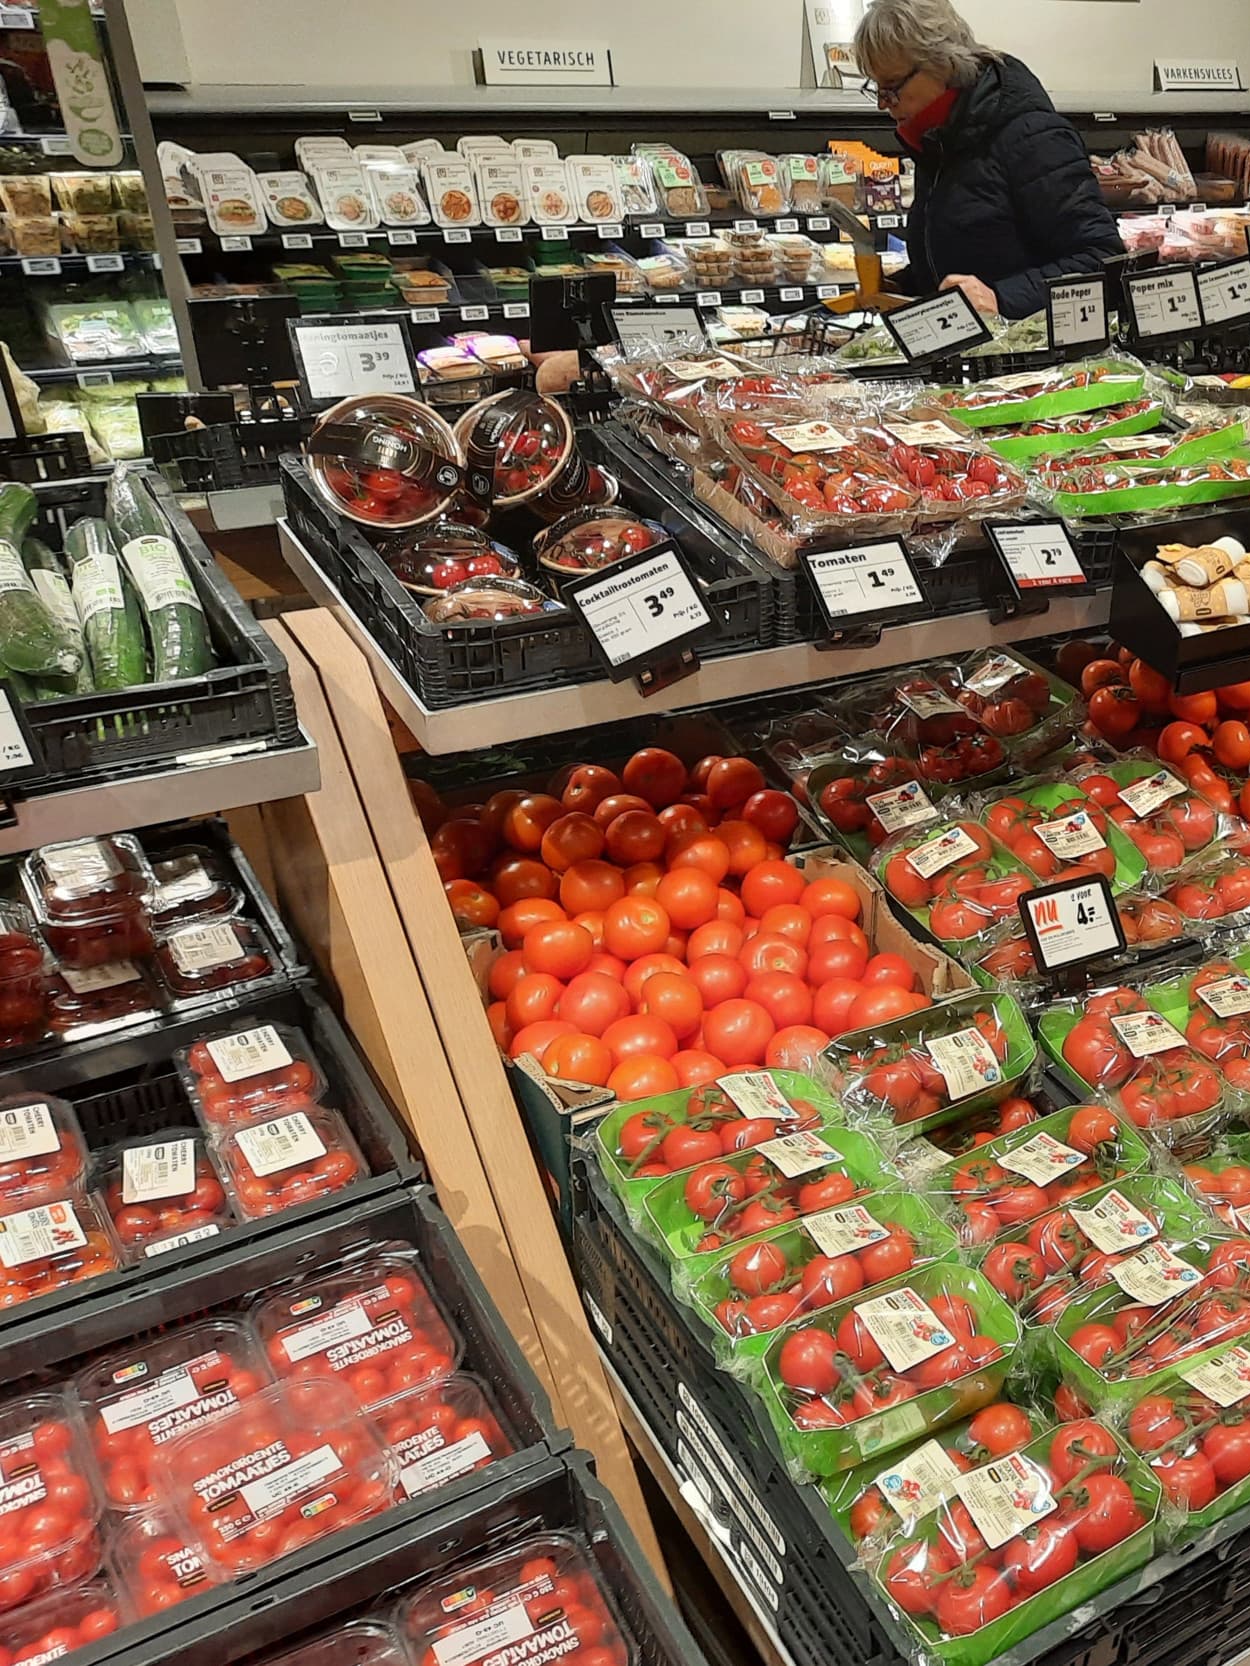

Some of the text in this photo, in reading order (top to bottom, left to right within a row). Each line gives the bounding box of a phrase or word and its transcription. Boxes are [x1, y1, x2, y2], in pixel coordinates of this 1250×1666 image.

[497, 50, 595, 66] VEGETARISCH
[1163, 67, 1233, 80] VARKENSVLEES
[1071, 288, 1091, 299] Peper
[809, 553, 867, 569] Tomaten
[326, 1319, 408, 1362] TOMAATJES
[330, 1331, 413, 1371] SNACKGROENTE
[148, 1390, 237, 1435] TOMAATJES
[193, 1440, 285, 1491] SNACKGROENTE
[198, 1450, 291, 1502] TOMAATJES
